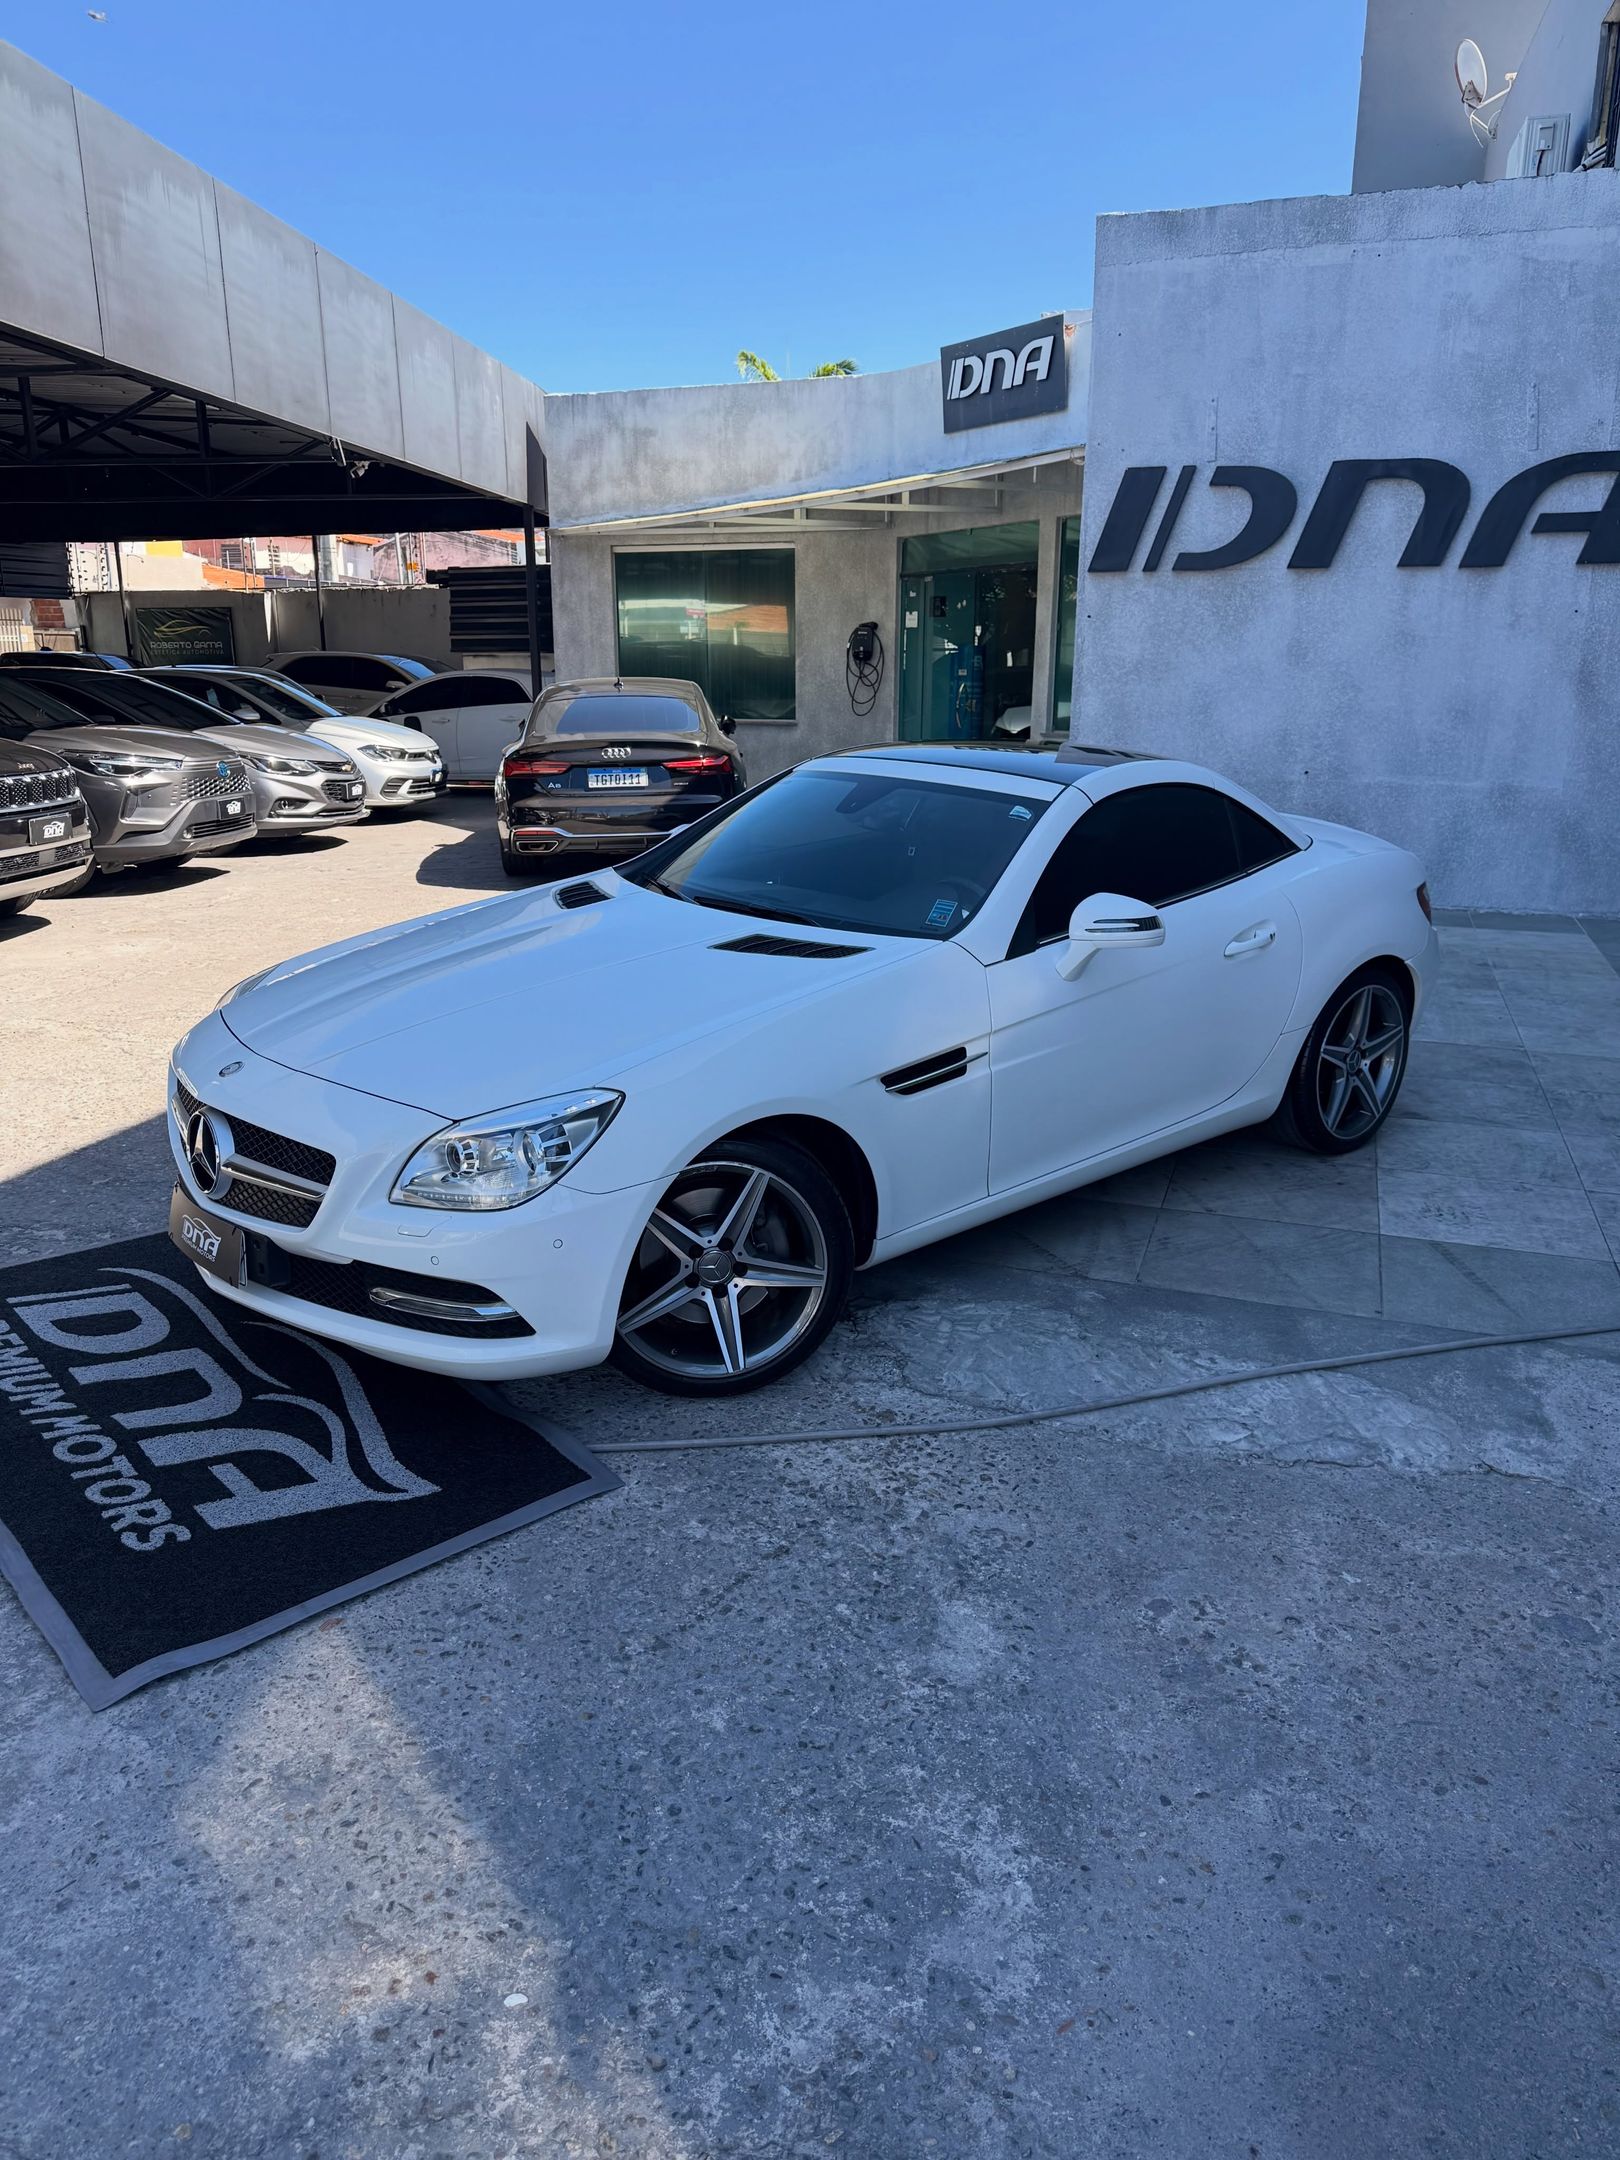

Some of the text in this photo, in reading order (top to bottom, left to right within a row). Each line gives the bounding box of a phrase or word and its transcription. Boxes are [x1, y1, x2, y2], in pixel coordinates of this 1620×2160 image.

[946, 335, 1055, 400] DNA
[1088, 450, 1620, 572] DNA
[150, 641, 223, 649] ROBERTO GAMA
[182, 1217, 221, 1257] DNA
[196, 1246, 216, 1263] MOTORS
[0, 1318, 192, 1552] MIUM MOTORS
[6, 1283, 410, 1530] DNA
